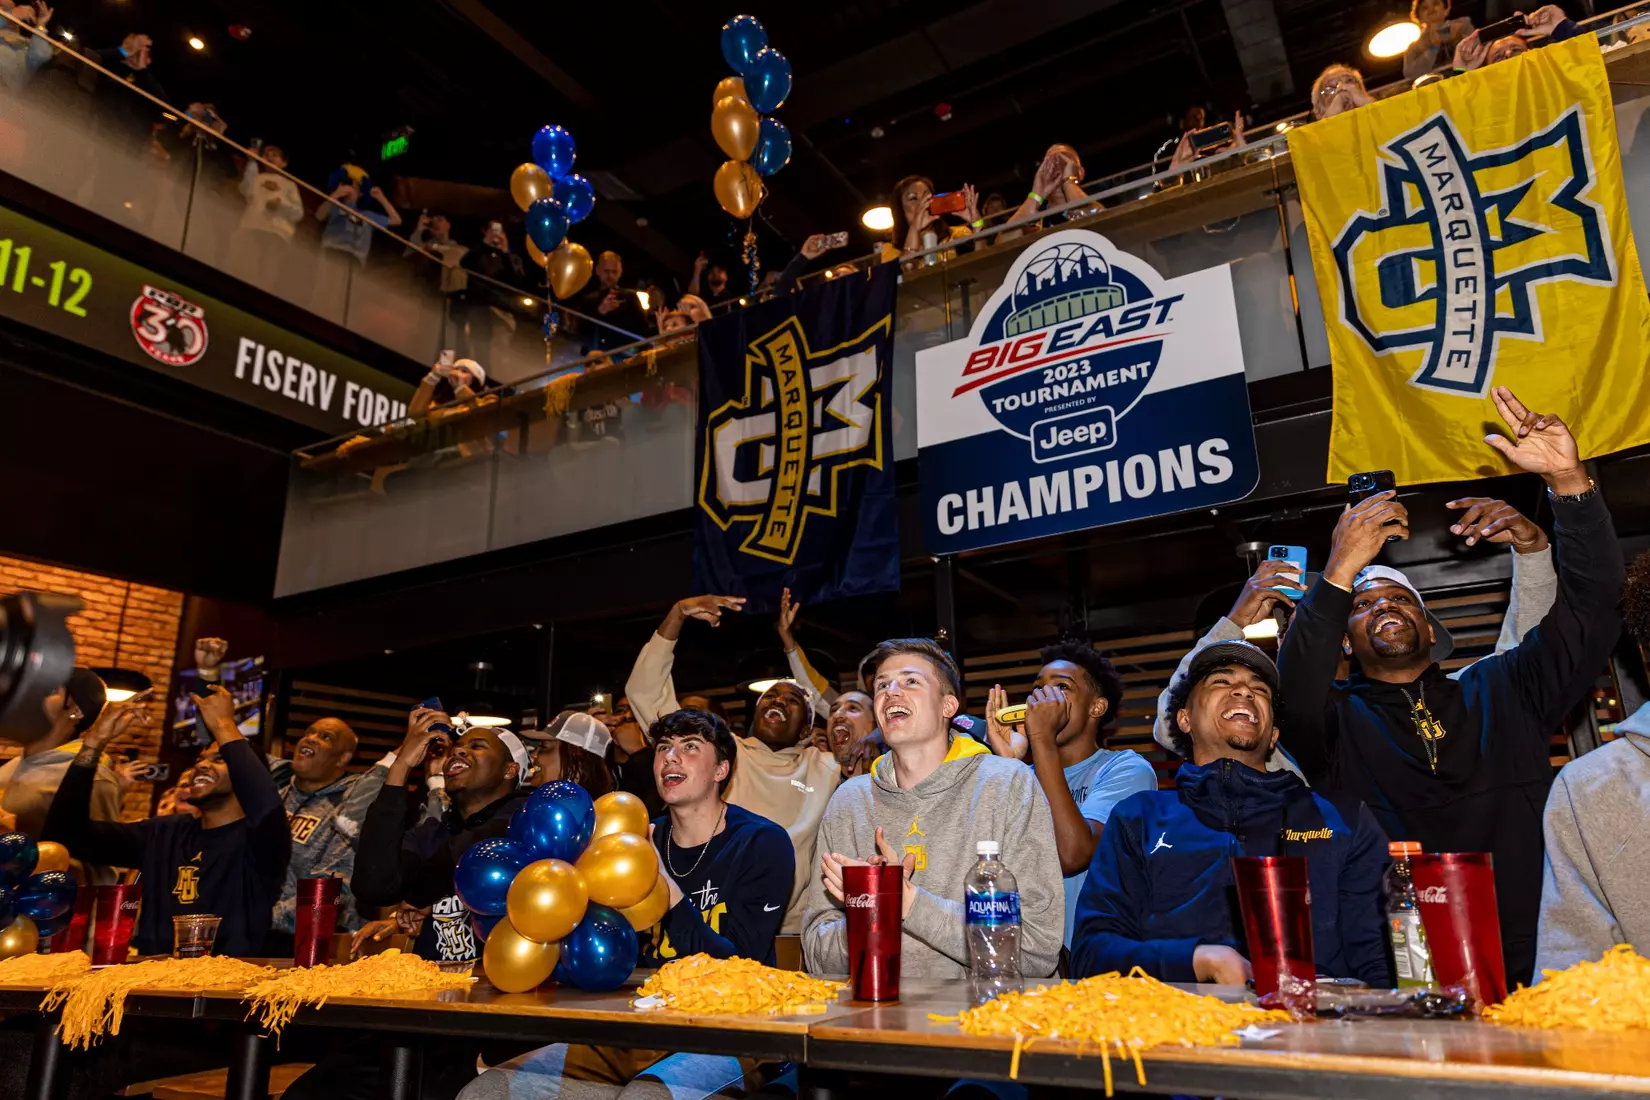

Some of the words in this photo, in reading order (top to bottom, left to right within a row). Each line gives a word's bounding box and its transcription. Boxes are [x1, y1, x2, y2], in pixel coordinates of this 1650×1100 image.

[0, 238, 93, 317] 11-12
[1420, 142, 1478, 369] MARQUETTE
[961, 331, 1048, 377] BIG
[1046, 293, 1185, 354] EAST
[235, 337, 337, 411] FISERV
[992, 361, 1152, 414] TOURNAMENT
[1043, 360, 1091, 384] 2023
[1040, 421, 1107, 450] Jeep
[1044, 399, 1085, 414] PRESENTED
[1086, 396, 1097, 405] BY
[769, 343, 803, 538] MARQUETTE
[936, 437, 1233, 535] CHAMPIONS
[691, 879, 719, 910] the
[969, 900, 1012, 914] AQUAFINA
